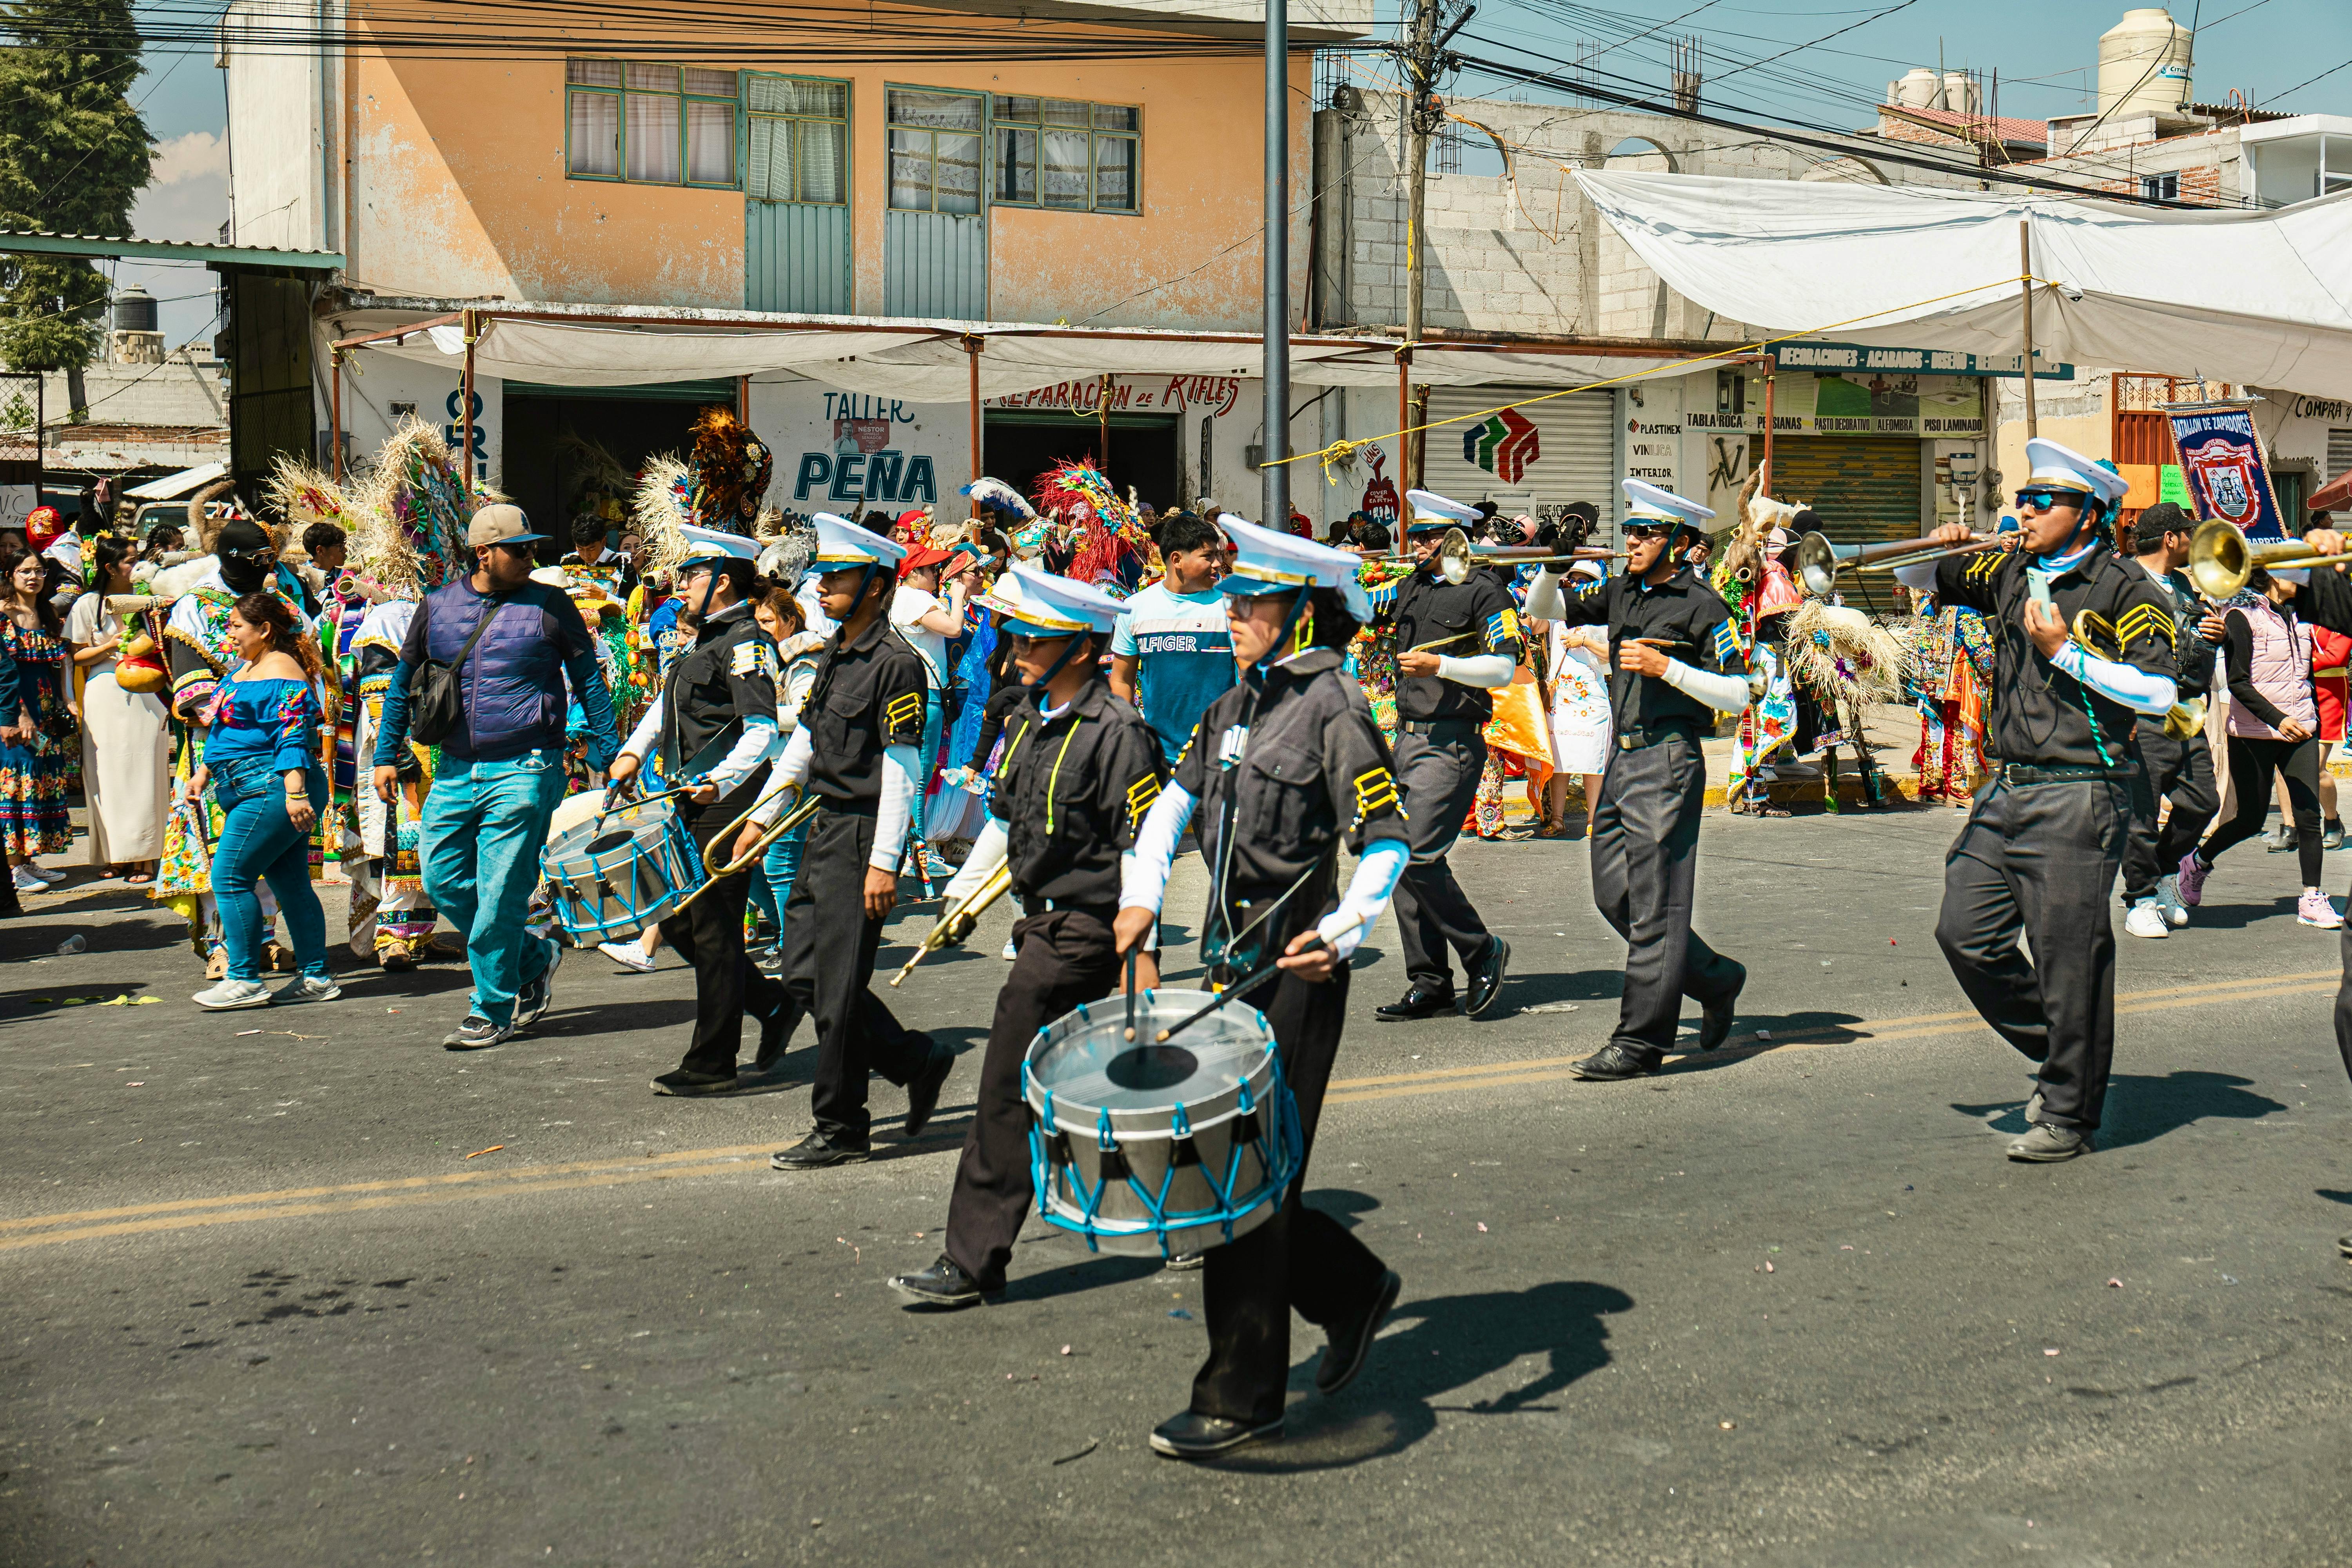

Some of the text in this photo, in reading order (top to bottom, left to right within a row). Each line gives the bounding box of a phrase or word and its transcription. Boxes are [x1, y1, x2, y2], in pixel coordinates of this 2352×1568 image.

[1779, 347, 1857, 367] DECORACIONES
[1866, 350, 1922, 368] ACABADOS
[1161, 376, 1240, 418] RIFLES
[823, 392, 915, 423] TALLER
[2295, 395, 2341, 420] COMPRA
[1687, 413, 1743, 428] TABLA ROCA
[1757, 416, 1802, 430] PESIANAS
[1814, 418, 1870, 431] PASTO DECORATIVO
[1877, 418, 1914, 431] ALFOMBRA
[1924, 419, 1983, 432] PISO LAMINADO
[2202, 417, 2212, 430] DE
[2212, 414, 2252, 438] ZAPADORES
[1364, 444, 1380, 464] SWP
[1633, 444, 1672, 456] VINILICA
[794, 450, 937, 503] PEÑA
[2163, 479, 2183, 487] Refrescos
